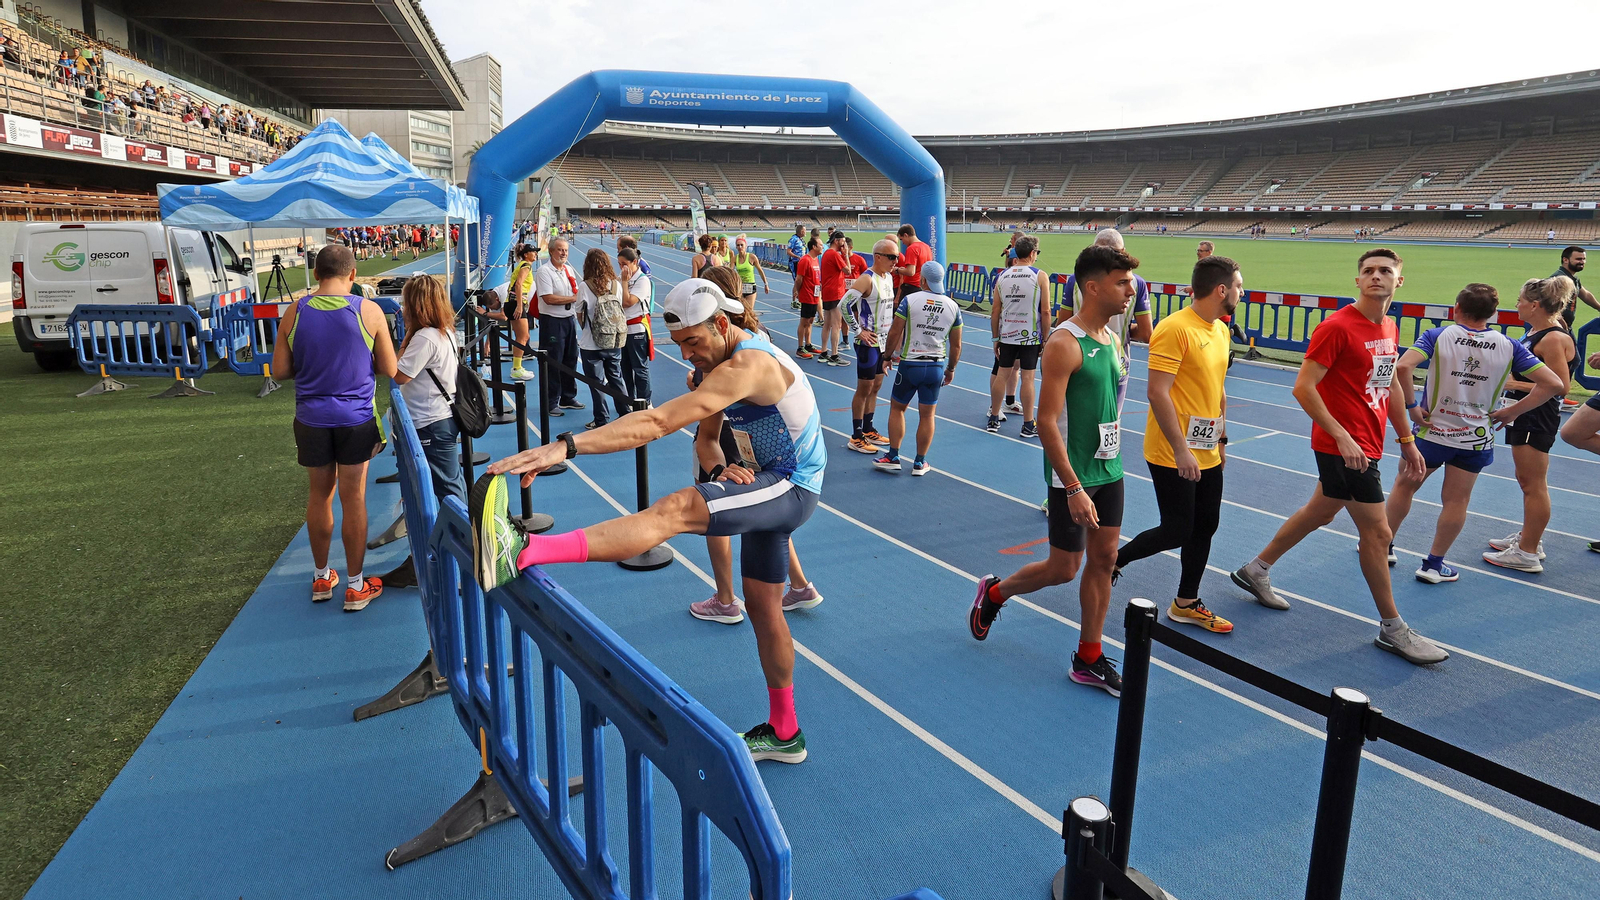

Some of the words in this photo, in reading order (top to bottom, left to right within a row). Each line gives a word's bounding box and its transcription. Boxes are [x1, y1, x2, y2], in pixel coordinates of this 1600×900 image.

[650, 89, 759, 101] Ayuntamiento
[762, 93, 781, 102] de
[784, 94, 822, 103] Jerez
[44, 129, 69, 144] PLAY
[64, 134, 94, 151] JEREZ
[127, 144, 145, 156] PLAY
[141, 147, 162, 162] JEREZ
[186, 155, 200, 165] PLAY
[90, 251, 130, 261] gescon
[89, 258, 112, 268] chip
[922, 304, 944, 315] SANTI
[47, 324, 68, 332] 7162
[916, 323, 946, 332] VETE-RUNNERS
[1455, 338, 1496, 350] FERRADA
[1376, 364, 1394, 377] 828
[1450, 370, 1489, 382] VETE-RUNNERS
[1459, 379, 1476, 387] JEREZ
[1192, 426, 1213, 438] 842
[1103, 431, 1118, 447] 833
